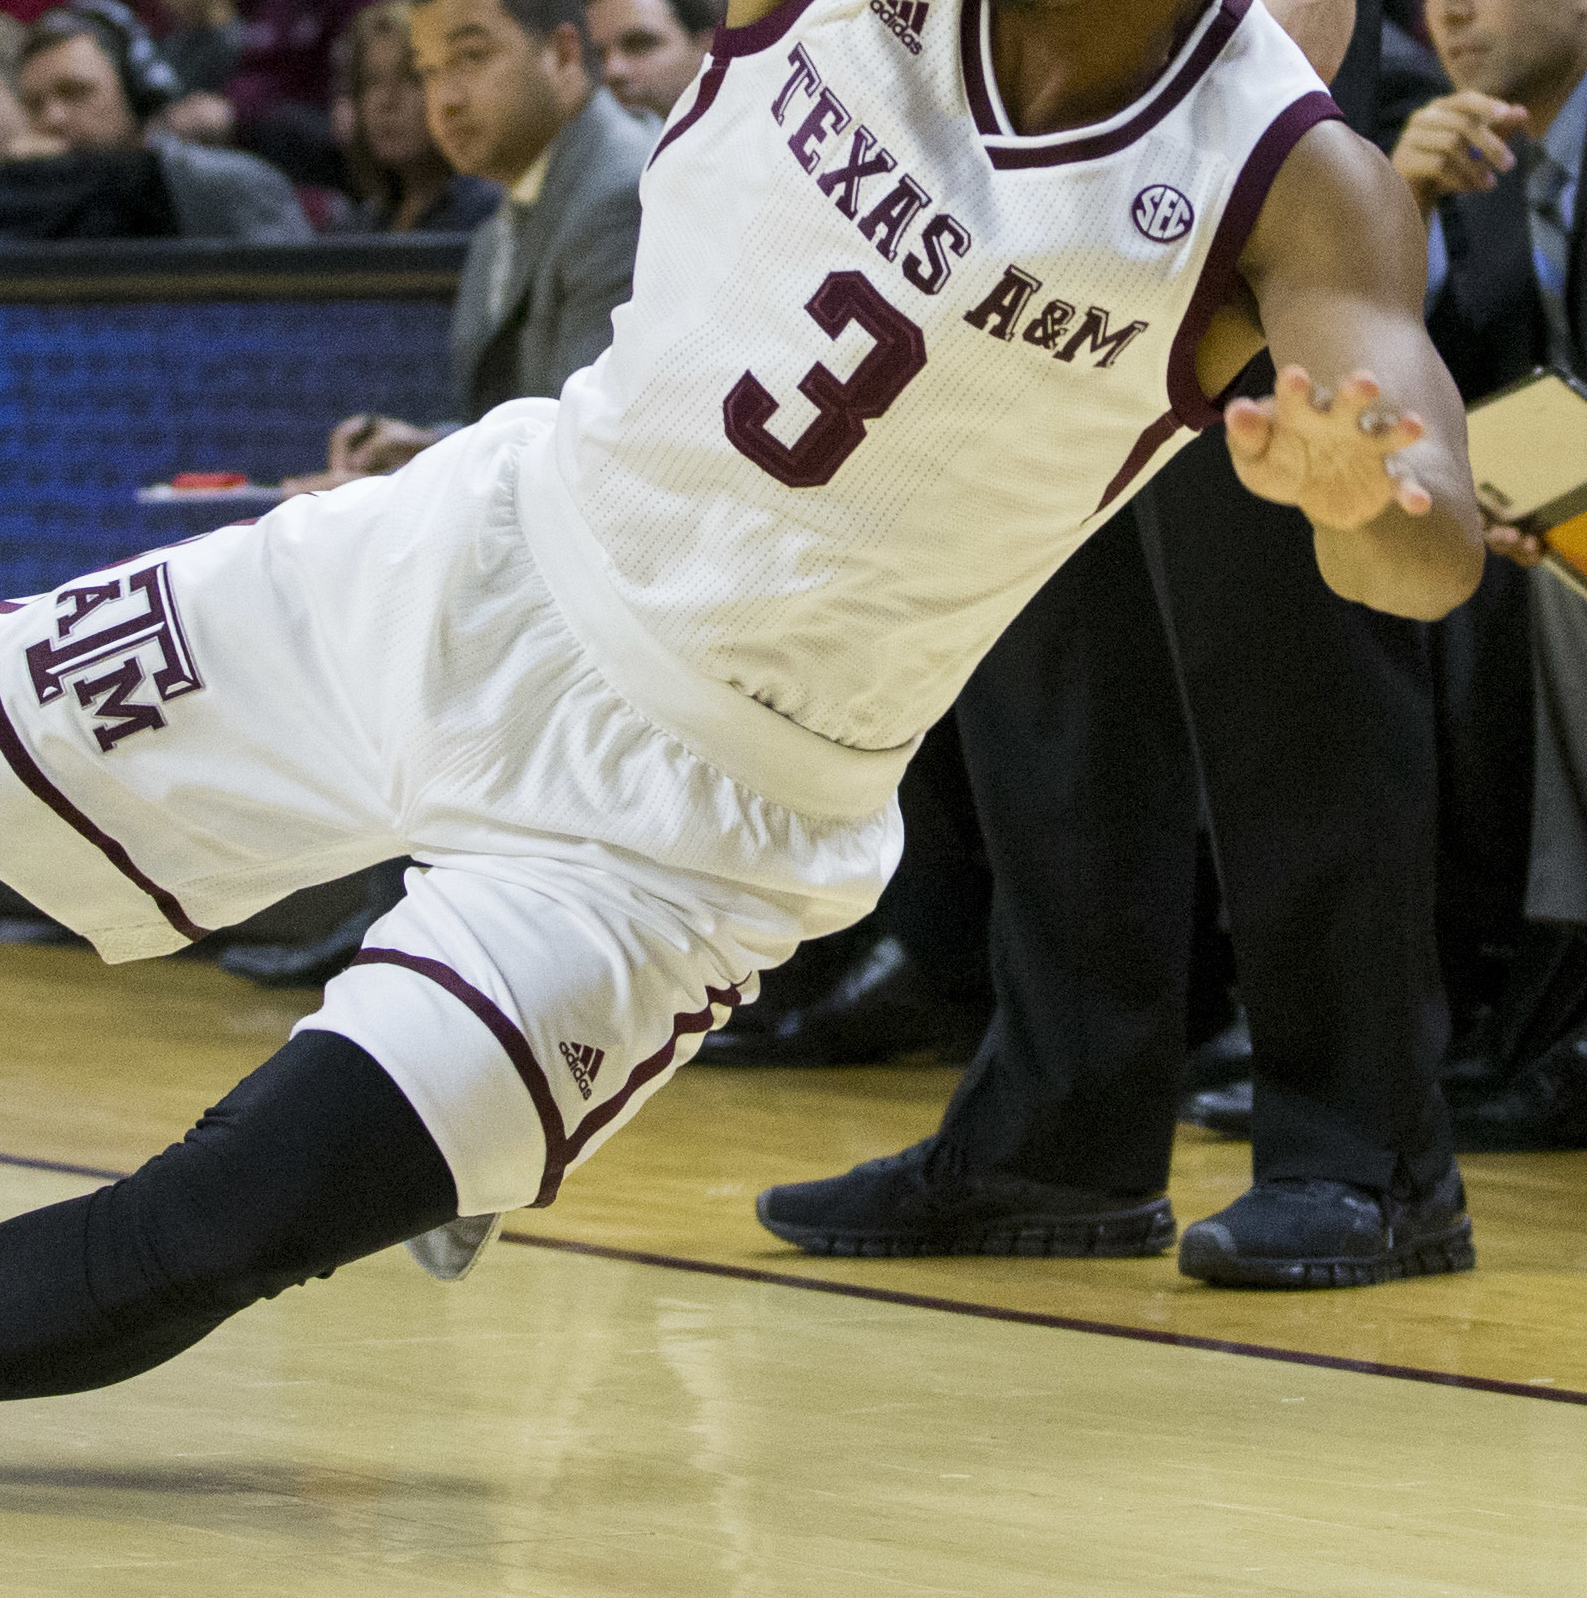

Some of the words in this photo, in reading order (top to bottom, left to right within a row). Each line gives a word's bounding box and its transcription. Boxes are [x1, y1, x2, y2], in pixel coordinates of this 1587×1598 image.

[870, 0, 922, 55] adidas
[769, 42, 972, 295] TEXAS
[963, 265, 1148, 369] A&M
[1134, 186, 1192, 240] SEC
[722, 270, 928, 488] 3
[558, 1041, 593, 1100] adidas
